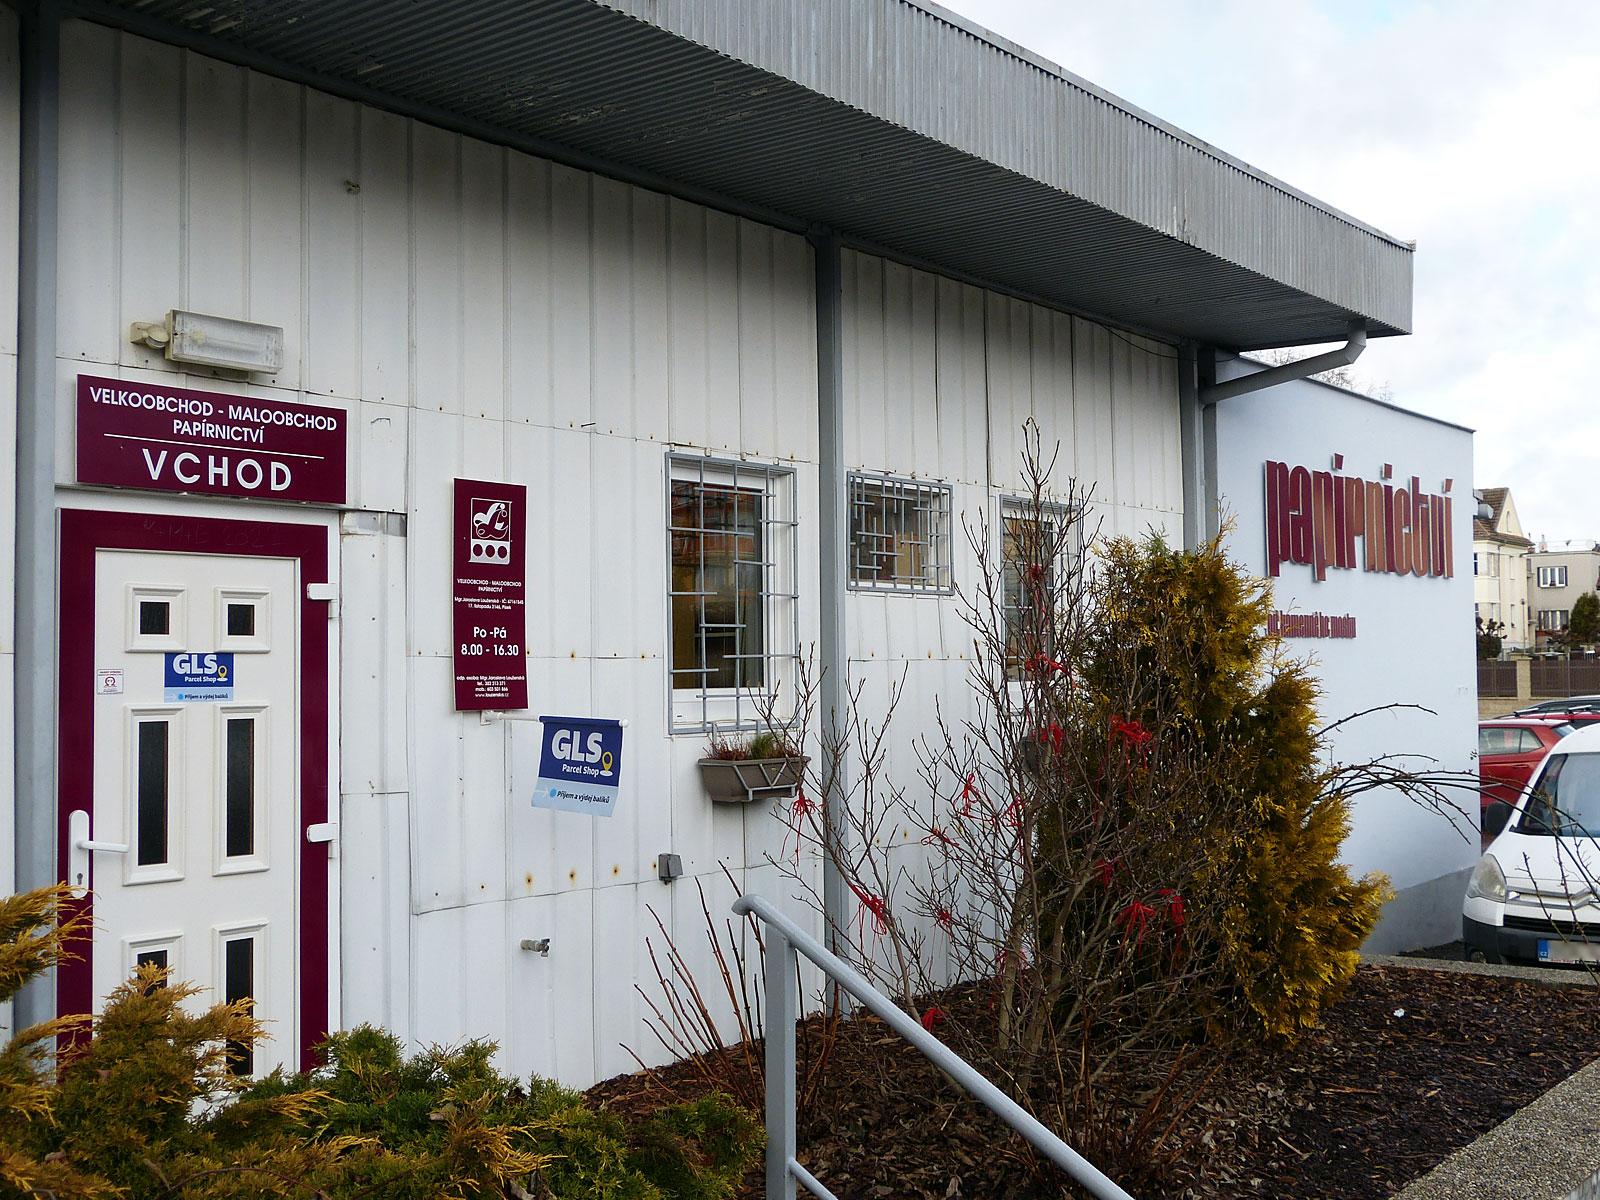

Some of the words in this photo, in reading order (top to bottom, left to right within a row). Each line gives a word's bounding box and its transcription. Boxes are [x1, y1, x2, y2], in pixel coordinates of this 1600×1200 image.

[90, 386, 213, 417] VELKOOBCHOD
[228, 405, 337, 431] MALOOBCHOD
[173, 419, 266, 444] PAPÍRNICTVÍ
[142, 448, 292, 491] VCHOD
[1265, 452, 1455, 582] papírnictví
[473, 627, 487, 638] Po
[461, 643, 483, 656] 8.00
[494, 644, 519, 656] 16.30
[172, 654, 218, 675] GLS
[551, 729, 603, 763] GLS
[562, 764, 582, 774] Parcel
[583, 766, 600, 778] Shop
[557, 790, 574, 799] Příjem
[579, 793, 592, 803] výdej
[593, 795, 610, 803] balíků
